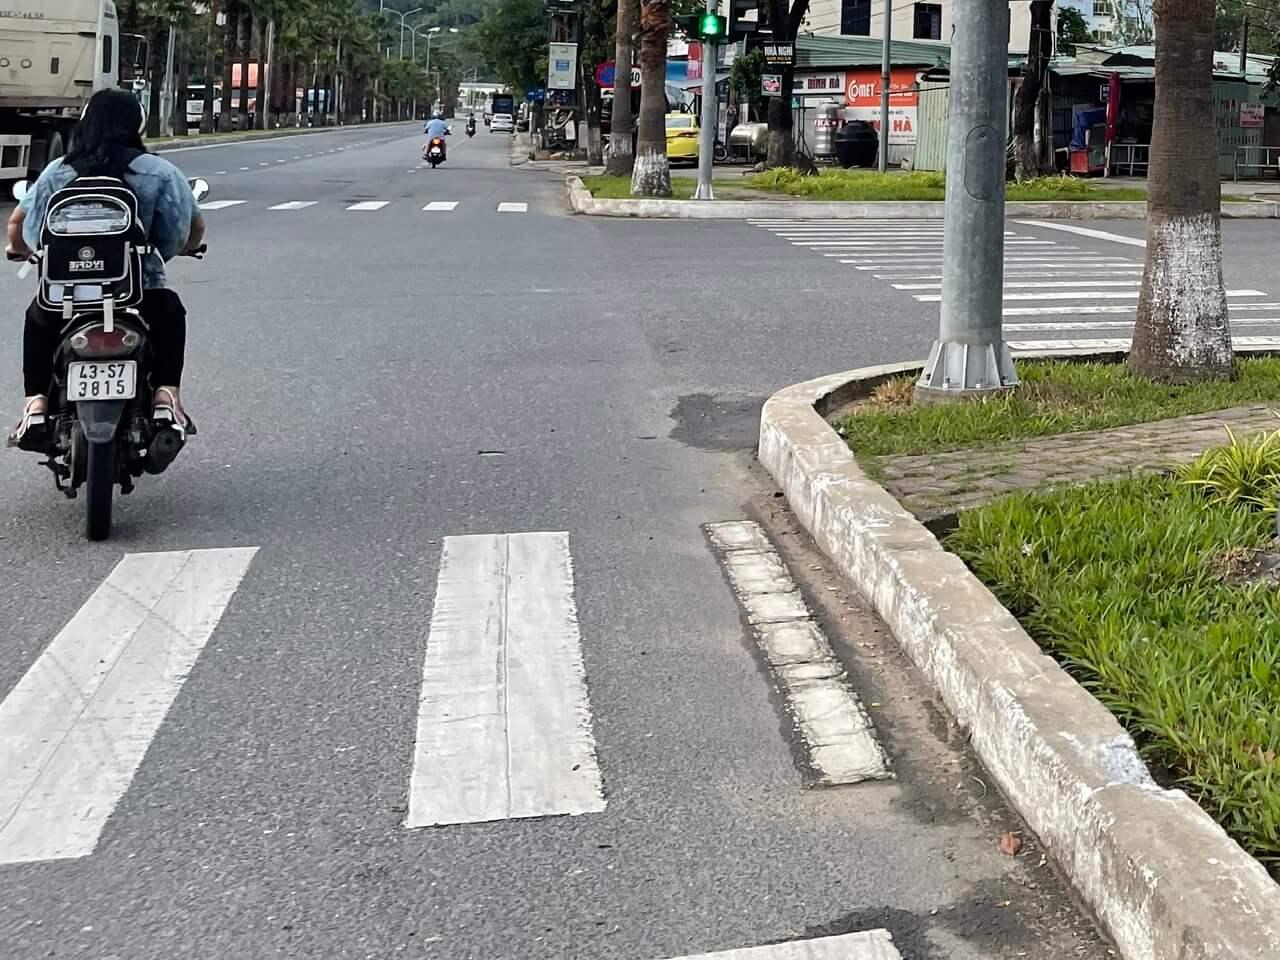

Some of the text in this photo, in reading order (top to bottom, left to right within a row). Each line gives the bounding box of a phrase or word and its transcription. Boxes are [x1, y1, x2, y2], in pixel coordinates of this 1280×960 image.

[893, 116, 913, 132] HÀ
[79, 364, 126, 379] 43-S7
[79, 380, 125, 397] 3815
